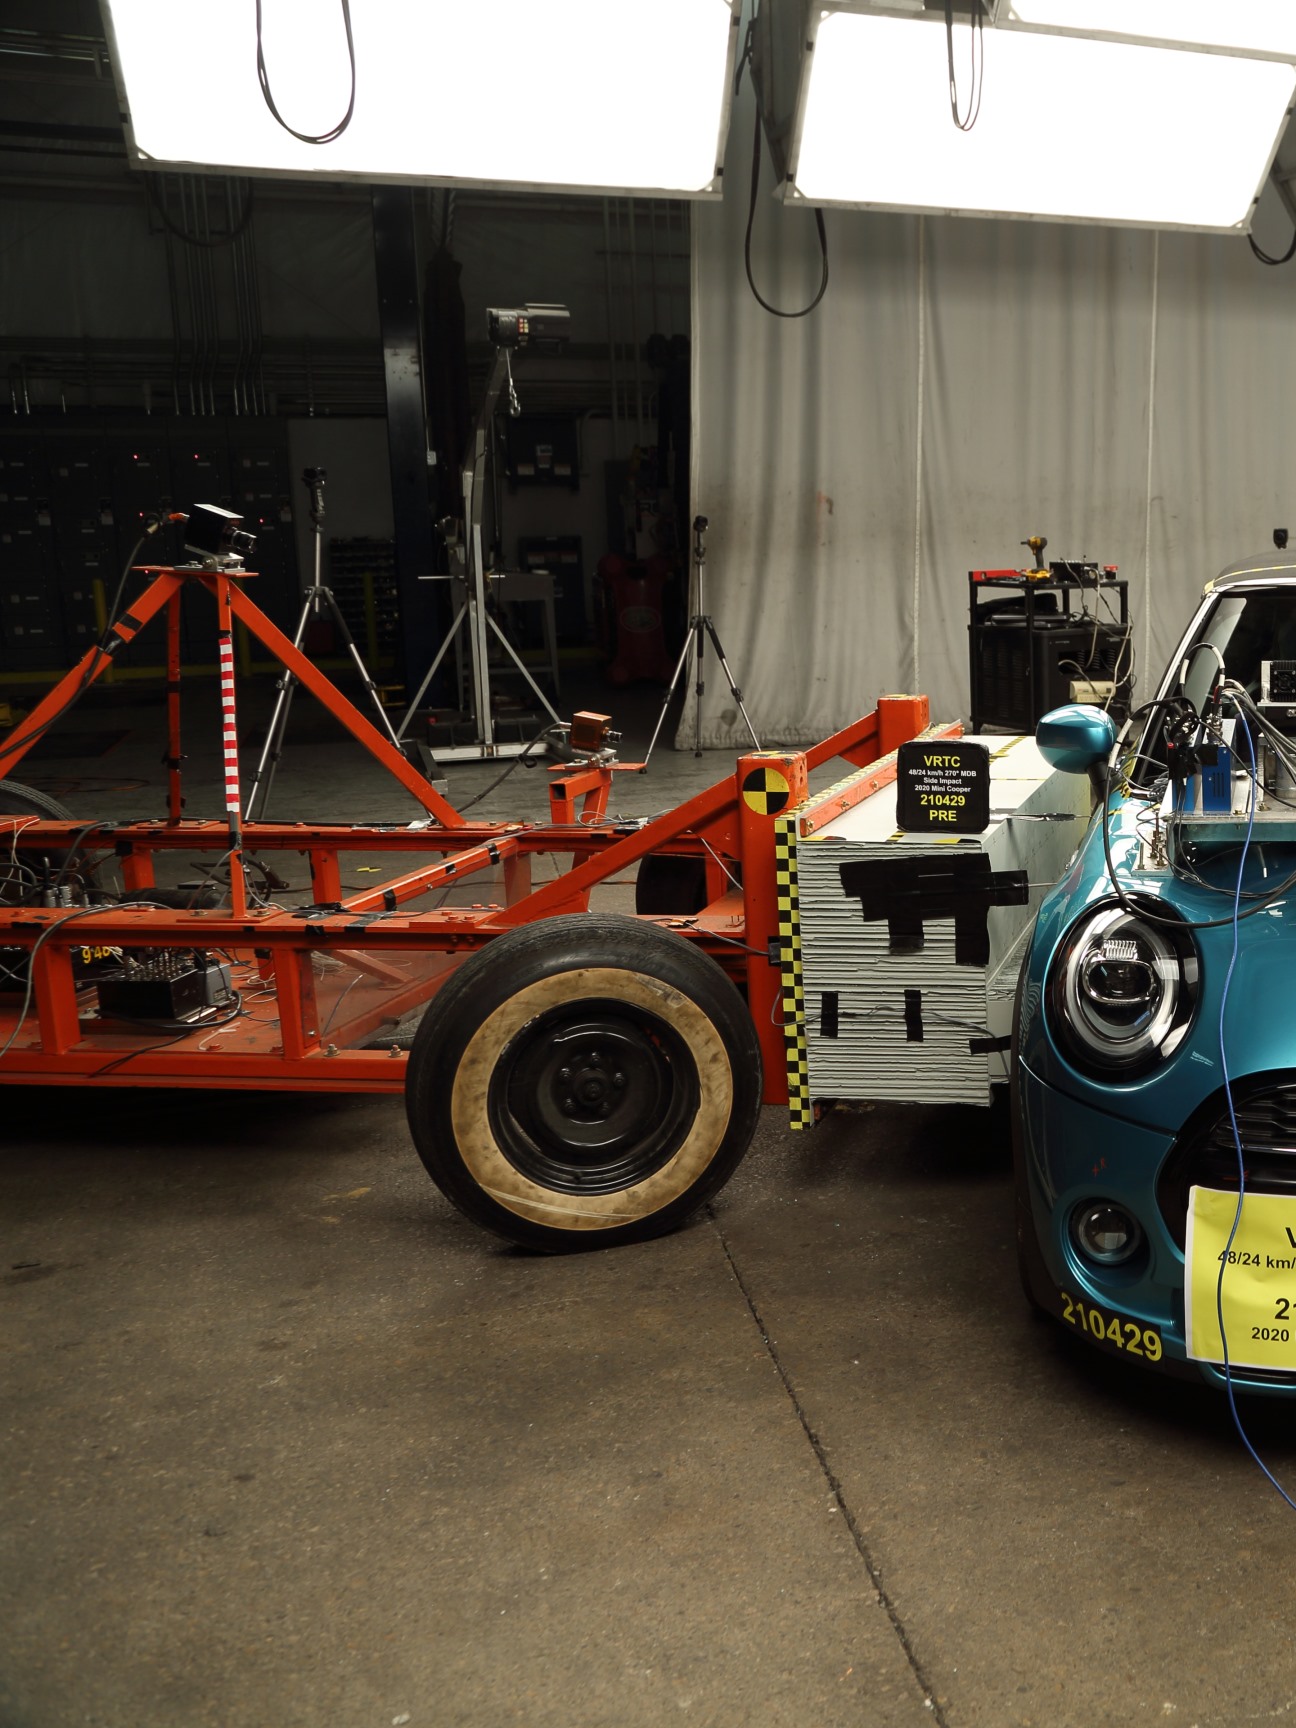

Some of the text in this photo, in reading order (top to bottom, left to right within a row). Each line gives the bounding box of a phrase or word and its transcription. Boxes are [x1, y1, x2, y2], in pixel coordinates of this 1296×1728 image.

[923, 755, 961, 767] VRTC
[908, 768, 926, 776] 48/24
[927, 769, 944, 777] km/h
[939, 777, 962, 785] Impact
[946, 785, 971, 793] Cooper
[920, 794, 966, 806] 210429
[929, 810, 957, 821] PRE
[1061, 1292, 1162, 1362] 210429
[1251, 1326, 1290, 1342] 2020
